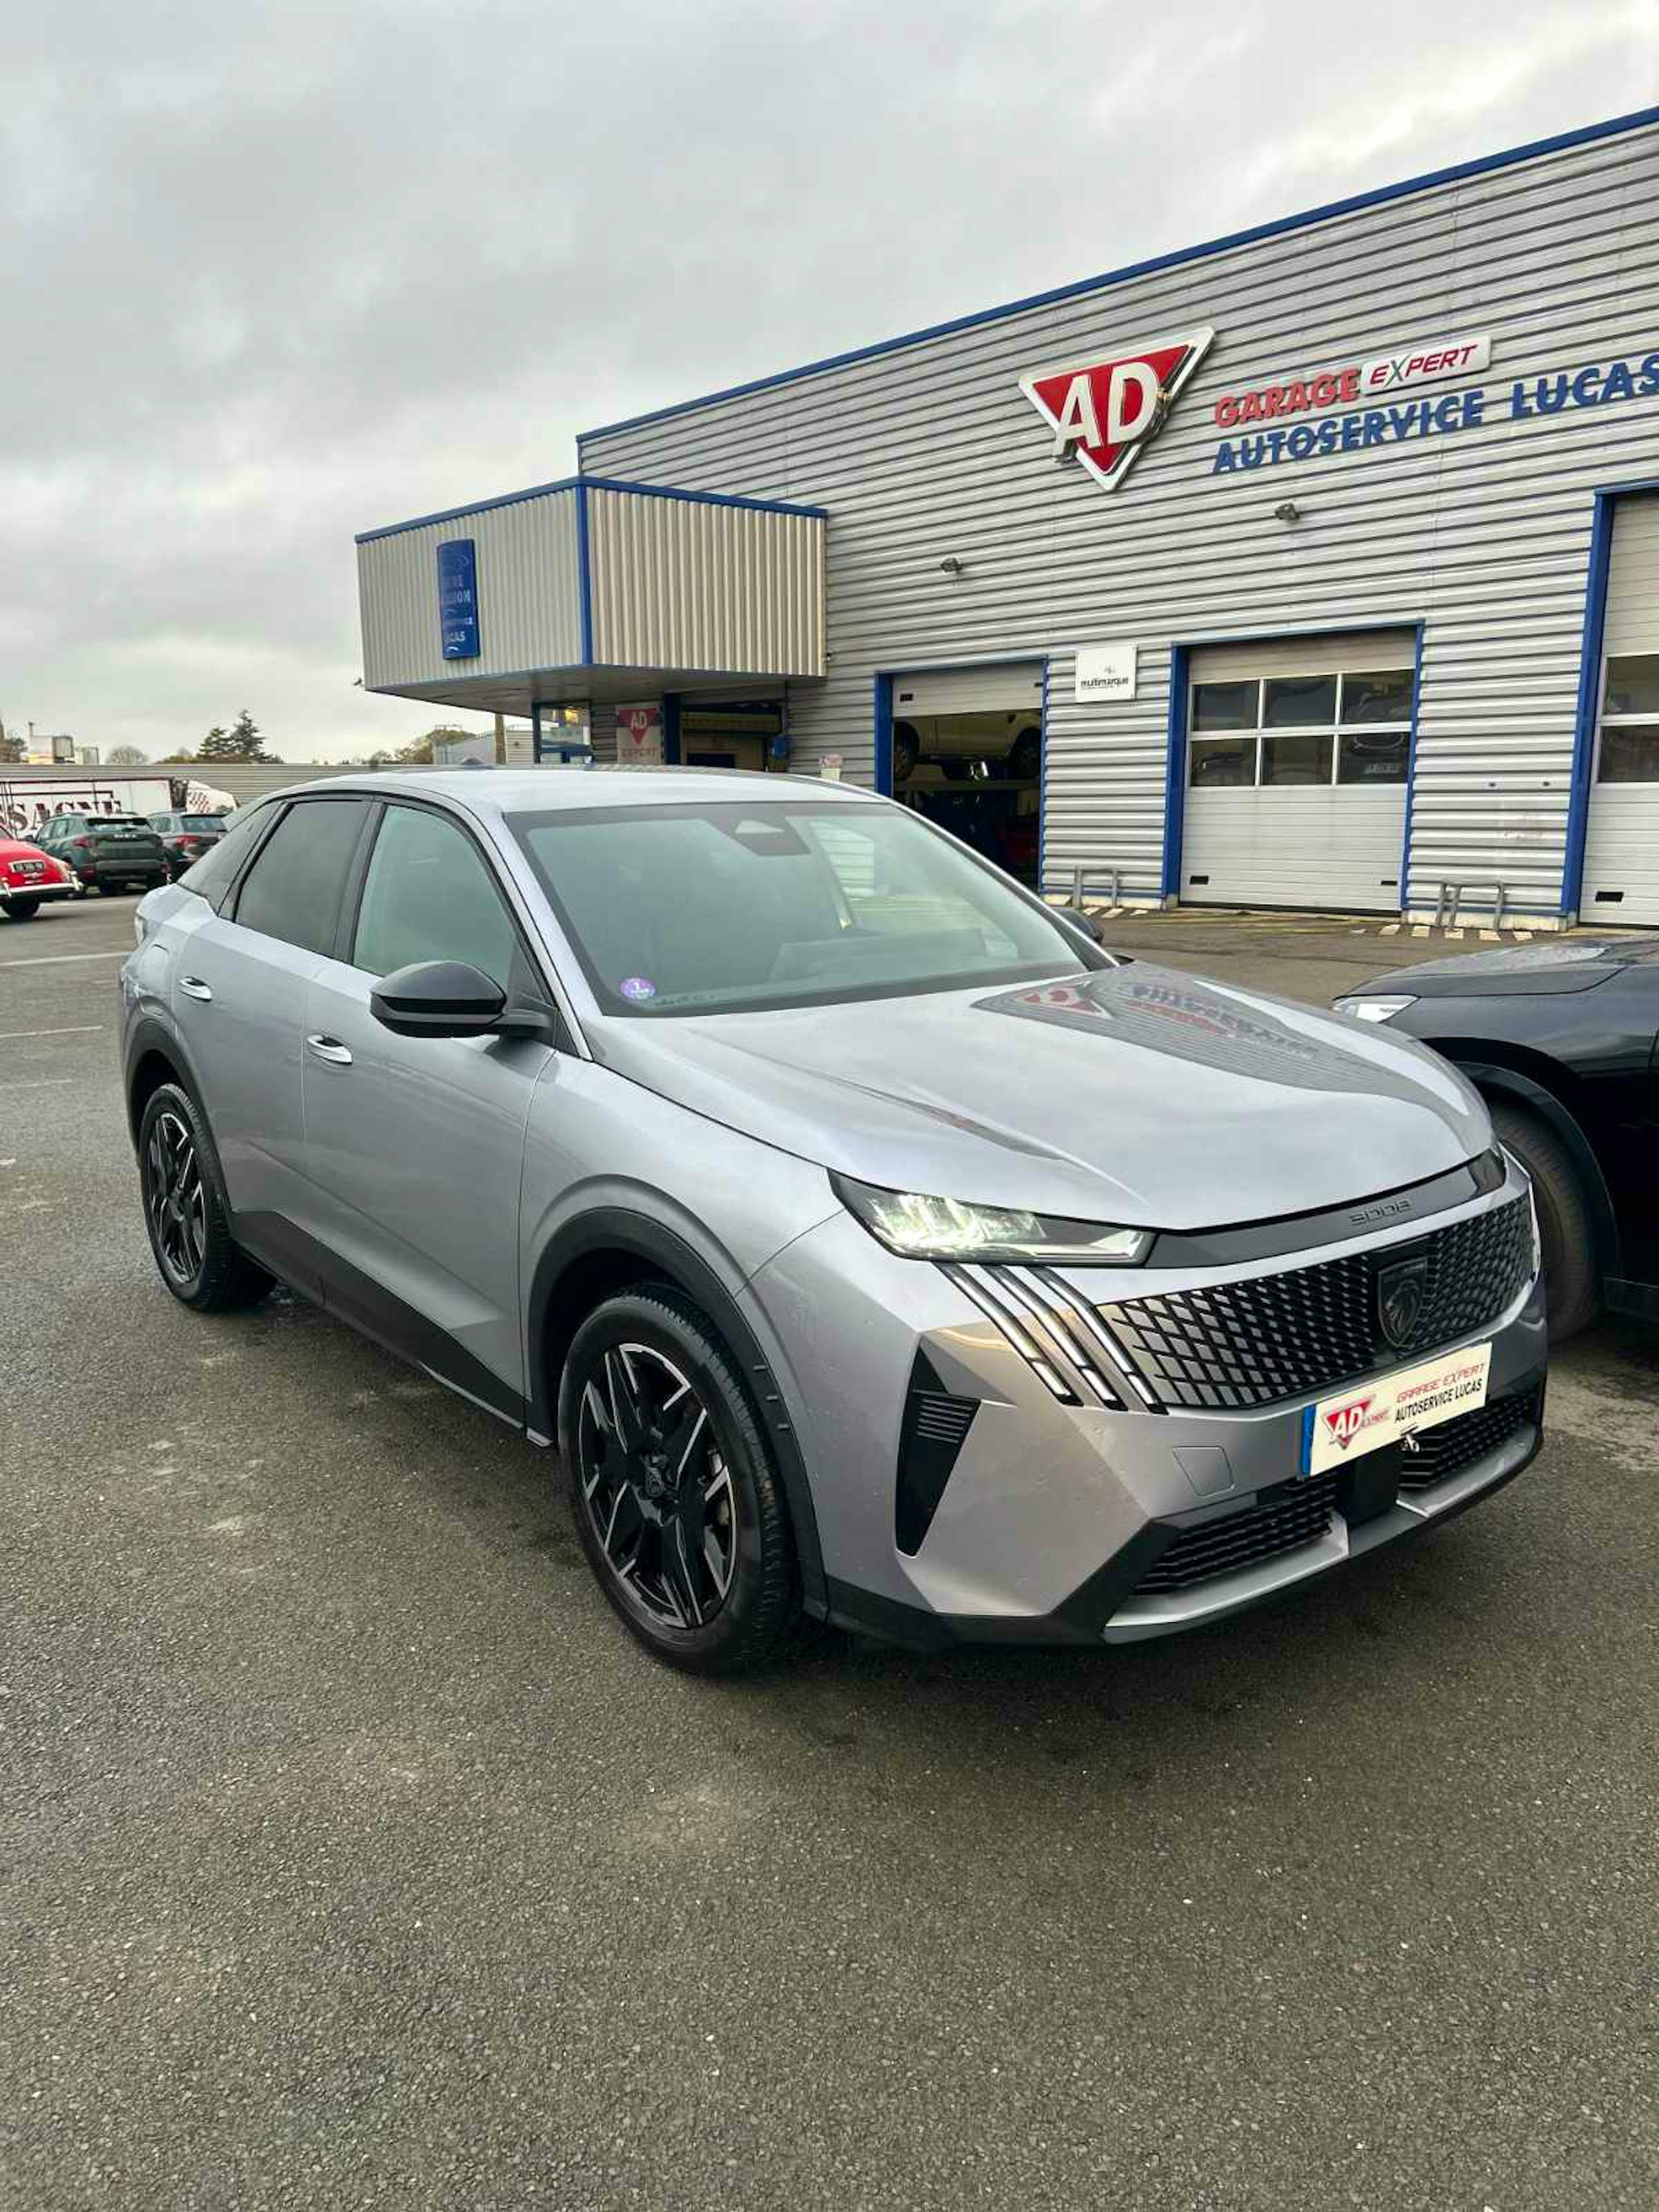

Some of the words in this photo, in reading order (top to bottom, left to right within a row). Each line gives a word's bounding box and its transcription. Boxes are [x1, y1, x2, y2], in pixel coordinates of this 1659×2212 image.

[1052, 361, 1160, 457] AD
[1213, 390, 1484, 474] AUTOSERVICE
[1512, 353, 1659, 420] LUCAS
[1215, 368, 1360, 428] GARAGE
[630, 711, 648, 731] AD
[1394, 1388, 1454, 1424] AUTOSERVICE
[1455, 1378, 1482, 1400] LUCAS
[1397, 1379, 1441, 1403] GARAGE
[1443, 1363, 1484, 1386] EXPERT
[1328, 1406, 1363, 1445] AD
